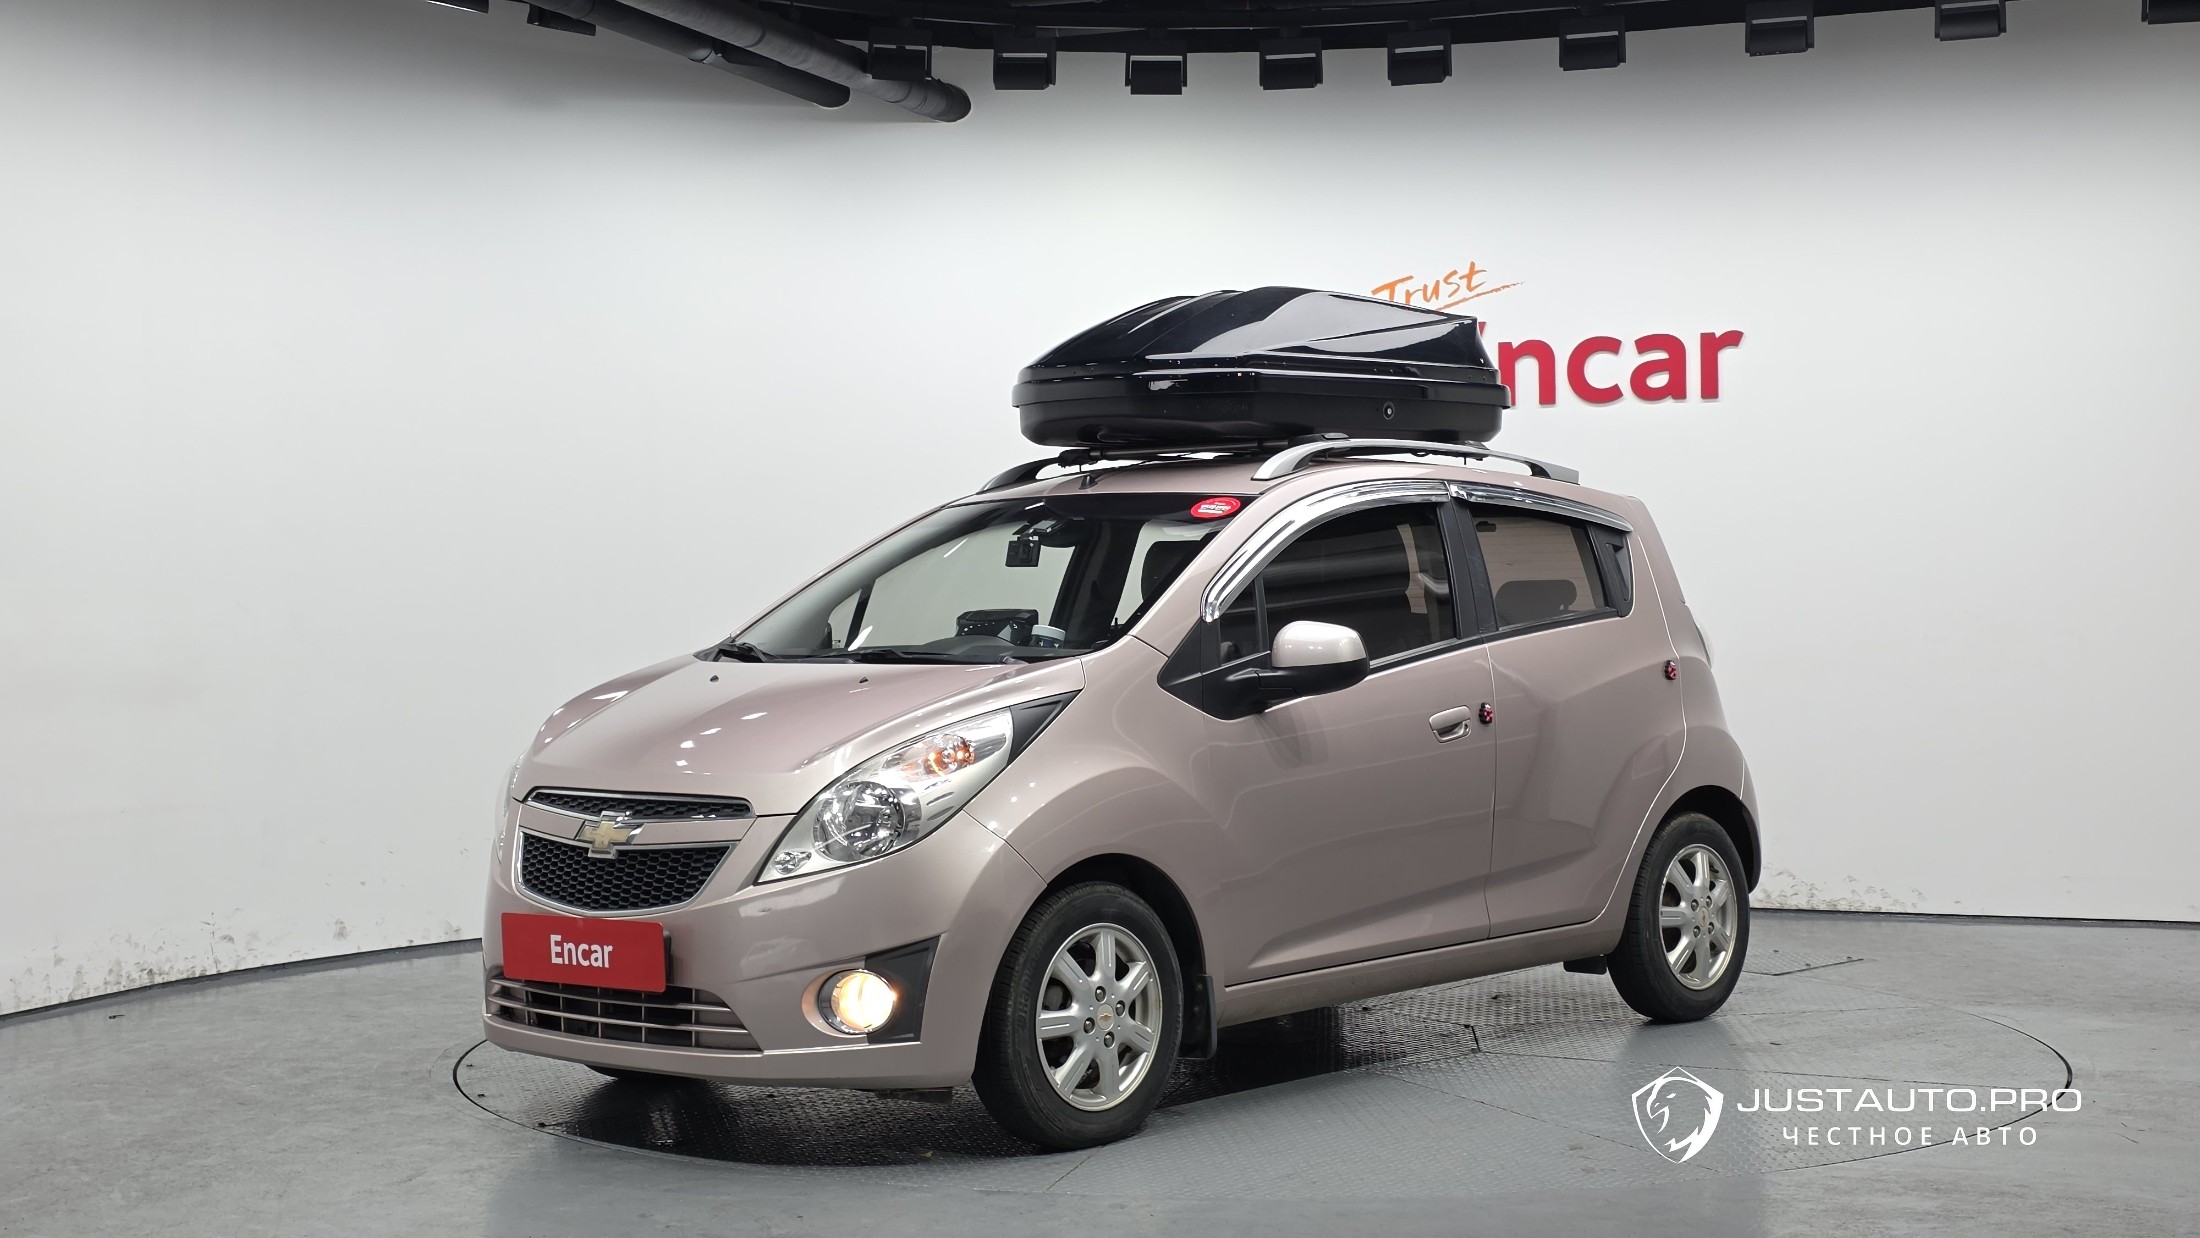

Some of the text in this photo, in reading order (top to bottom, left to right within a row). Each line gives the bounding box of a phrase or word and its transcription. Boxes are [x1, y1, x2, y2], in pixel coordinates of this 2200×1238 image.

[1371, 260, 1488, 305] Trust
[1478, 322, 1744, 406] ncar
[550, 934, 613, 968] Encar
